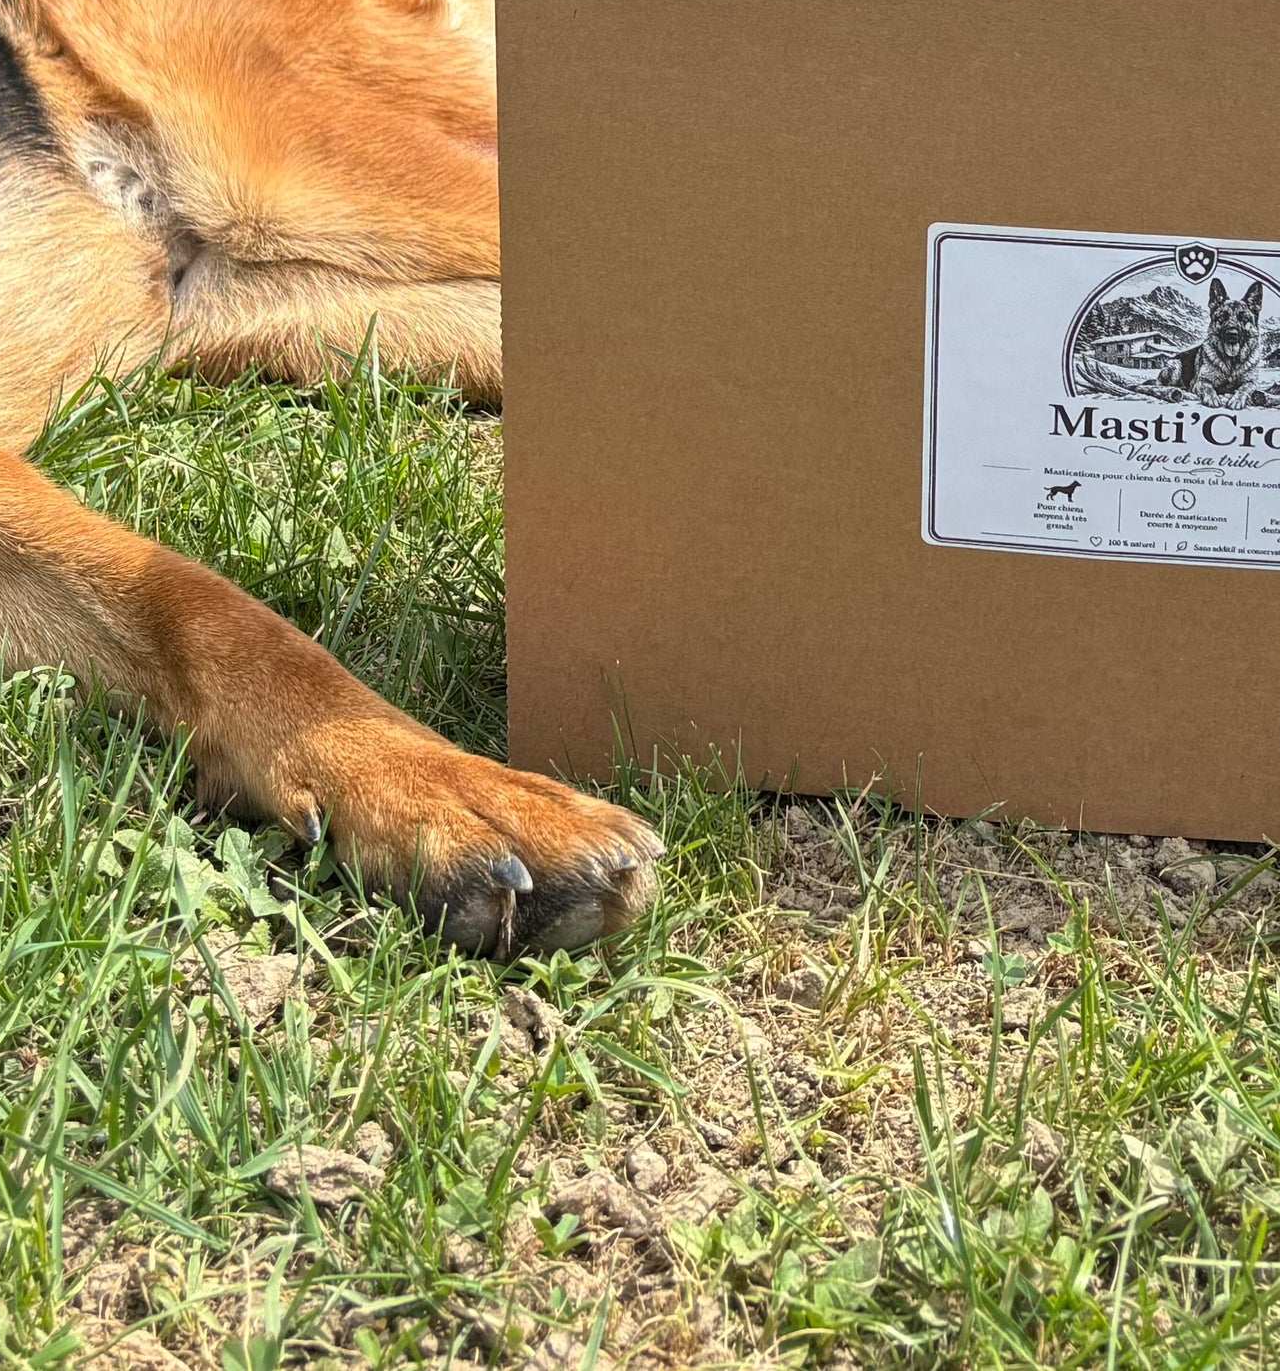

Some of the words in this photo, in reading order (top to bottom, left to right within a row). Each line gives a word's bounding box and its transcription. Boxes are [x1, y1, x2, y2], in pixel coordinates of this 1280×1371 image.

[1117, 442, 1170, 471] Vaya
[1173, 452, 1191, 465] et
[1194, 456, 1214, 466] sa
[1218, 453, 1265, 469] tribu
[1043, 467, 1101, 479] Mastications
[1102, 473, 1122, 481] pour
[1125, 473, 1154, 482] chiens
[1156, 474, 1171, 483] dès
[1183, 477, 1205, 485] mois
[1208, 478, 1219, 487] (si
[1221, 478, 1233, 487] les
[1236, 479, 1260, 488] dents
[1261, 482, 1280, 490] sont
[1037, 502, 1057, 511] Pour
[1058, 504, 1084, 514] chiens
[1033, 513, 1064, 521] moyens
[1065, 513, 1071, 521] à
[1072, 514, 1087, 523] très
[1140, 511, 1164, 519] Durée
[1177, 513, 1227, 523] mastications
[1174, 521, 1180, 529] à
[1181, 523, 1218, 531] moyenne
[1108, 538, 1121, 547] 100
[1130, 541, 1156, 549] naturel
[1194, 544, 1211, 552] Sans
[1212, 545, 1236, 553] additif
